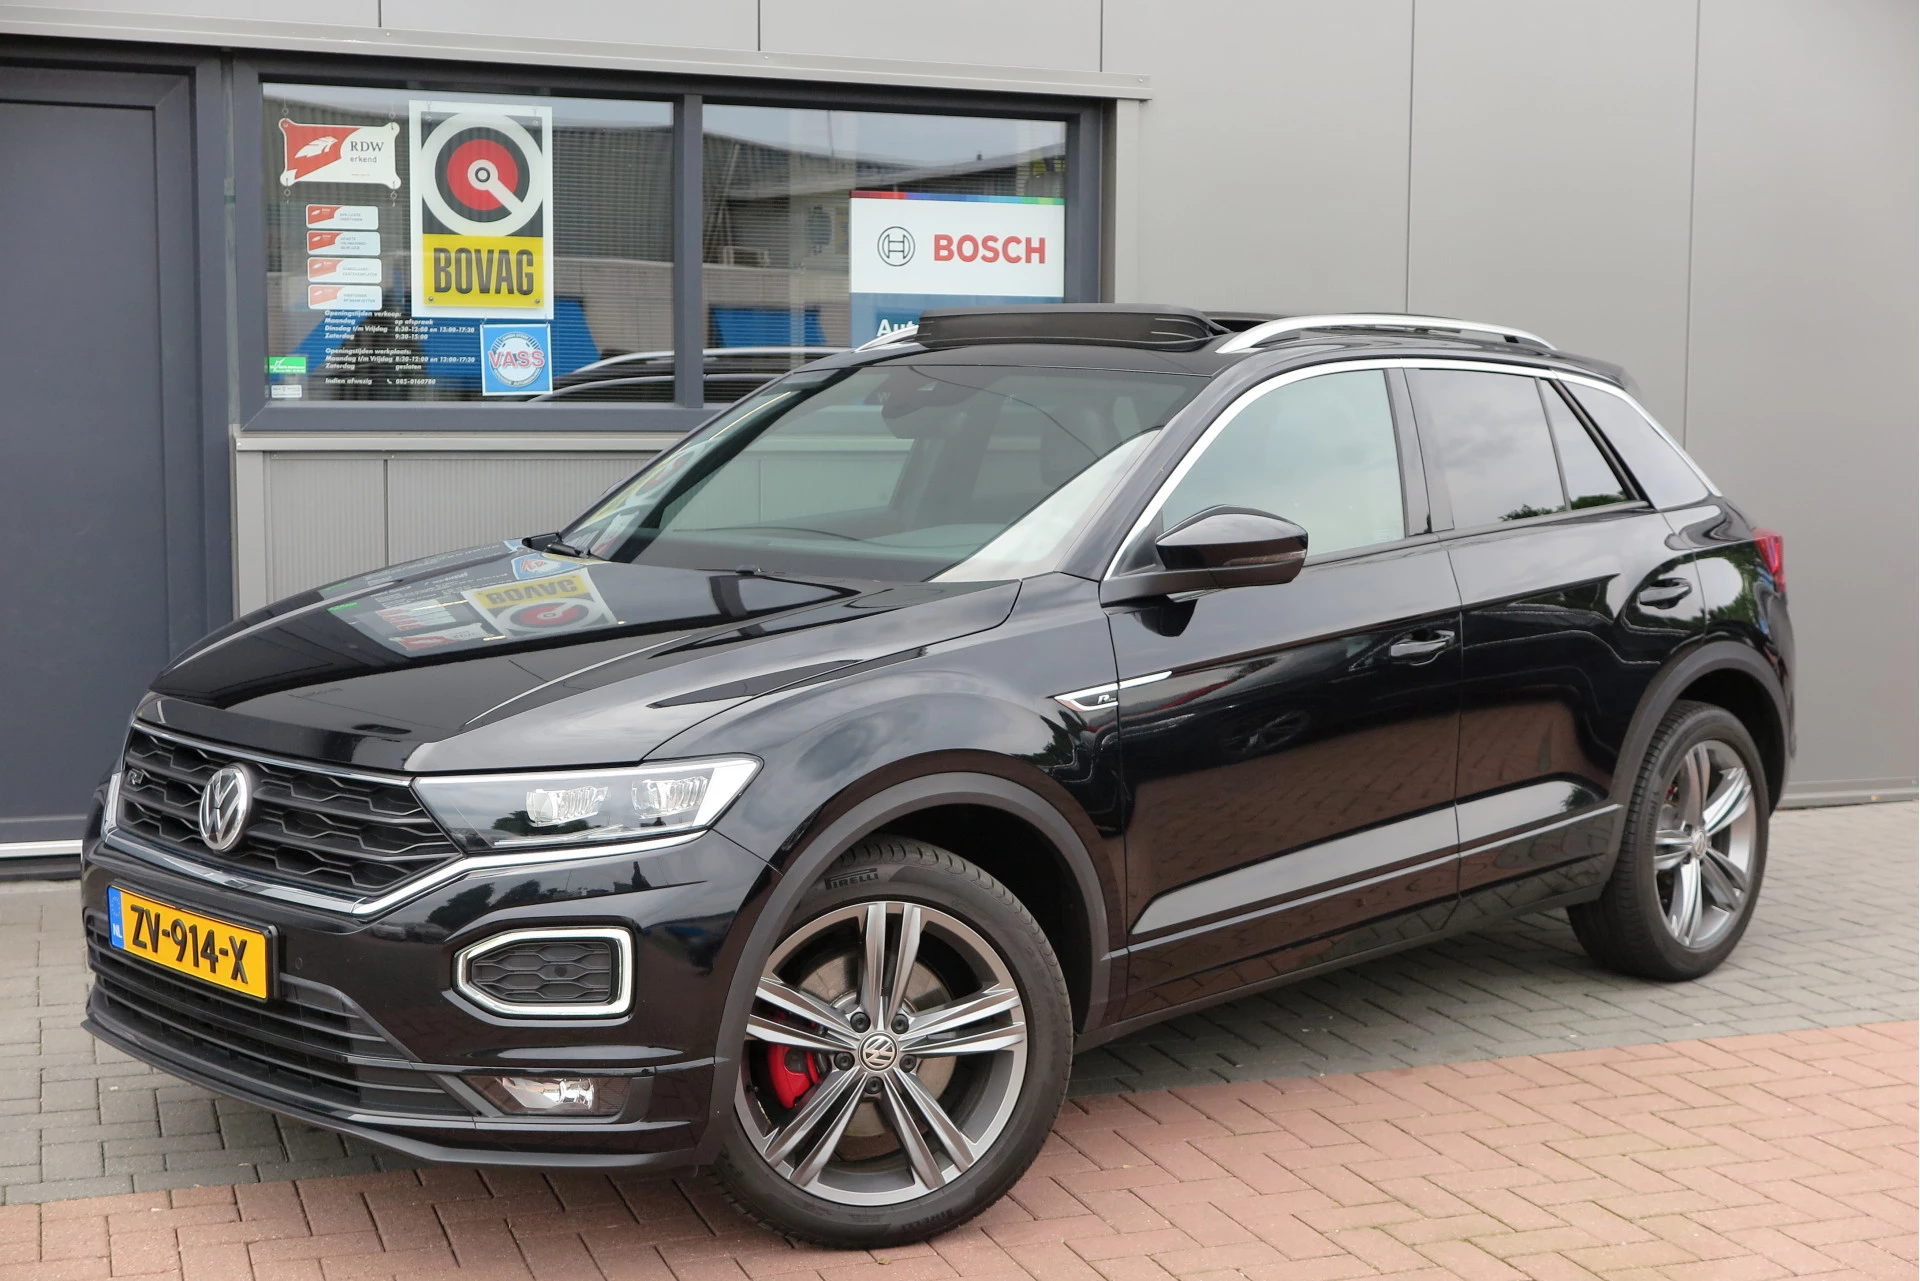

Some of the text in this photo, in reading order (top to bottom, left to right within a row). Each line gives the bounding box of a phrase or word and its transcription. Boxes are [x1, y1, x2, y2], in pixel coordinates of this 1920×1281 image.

[350, 141, 384, 152] RDW
[934, 234, 1046, 264] BOSCH
[433, 247, 534, 295] BOVAG
[325, 310, 372, 318] Openingstijden
[489, 350, 545, 368] VASS
[824, 867, 879, 890] PIRELLI
[112, 923, 123, 938] NL
[131, 904, 248, 984] ZV-914-X
